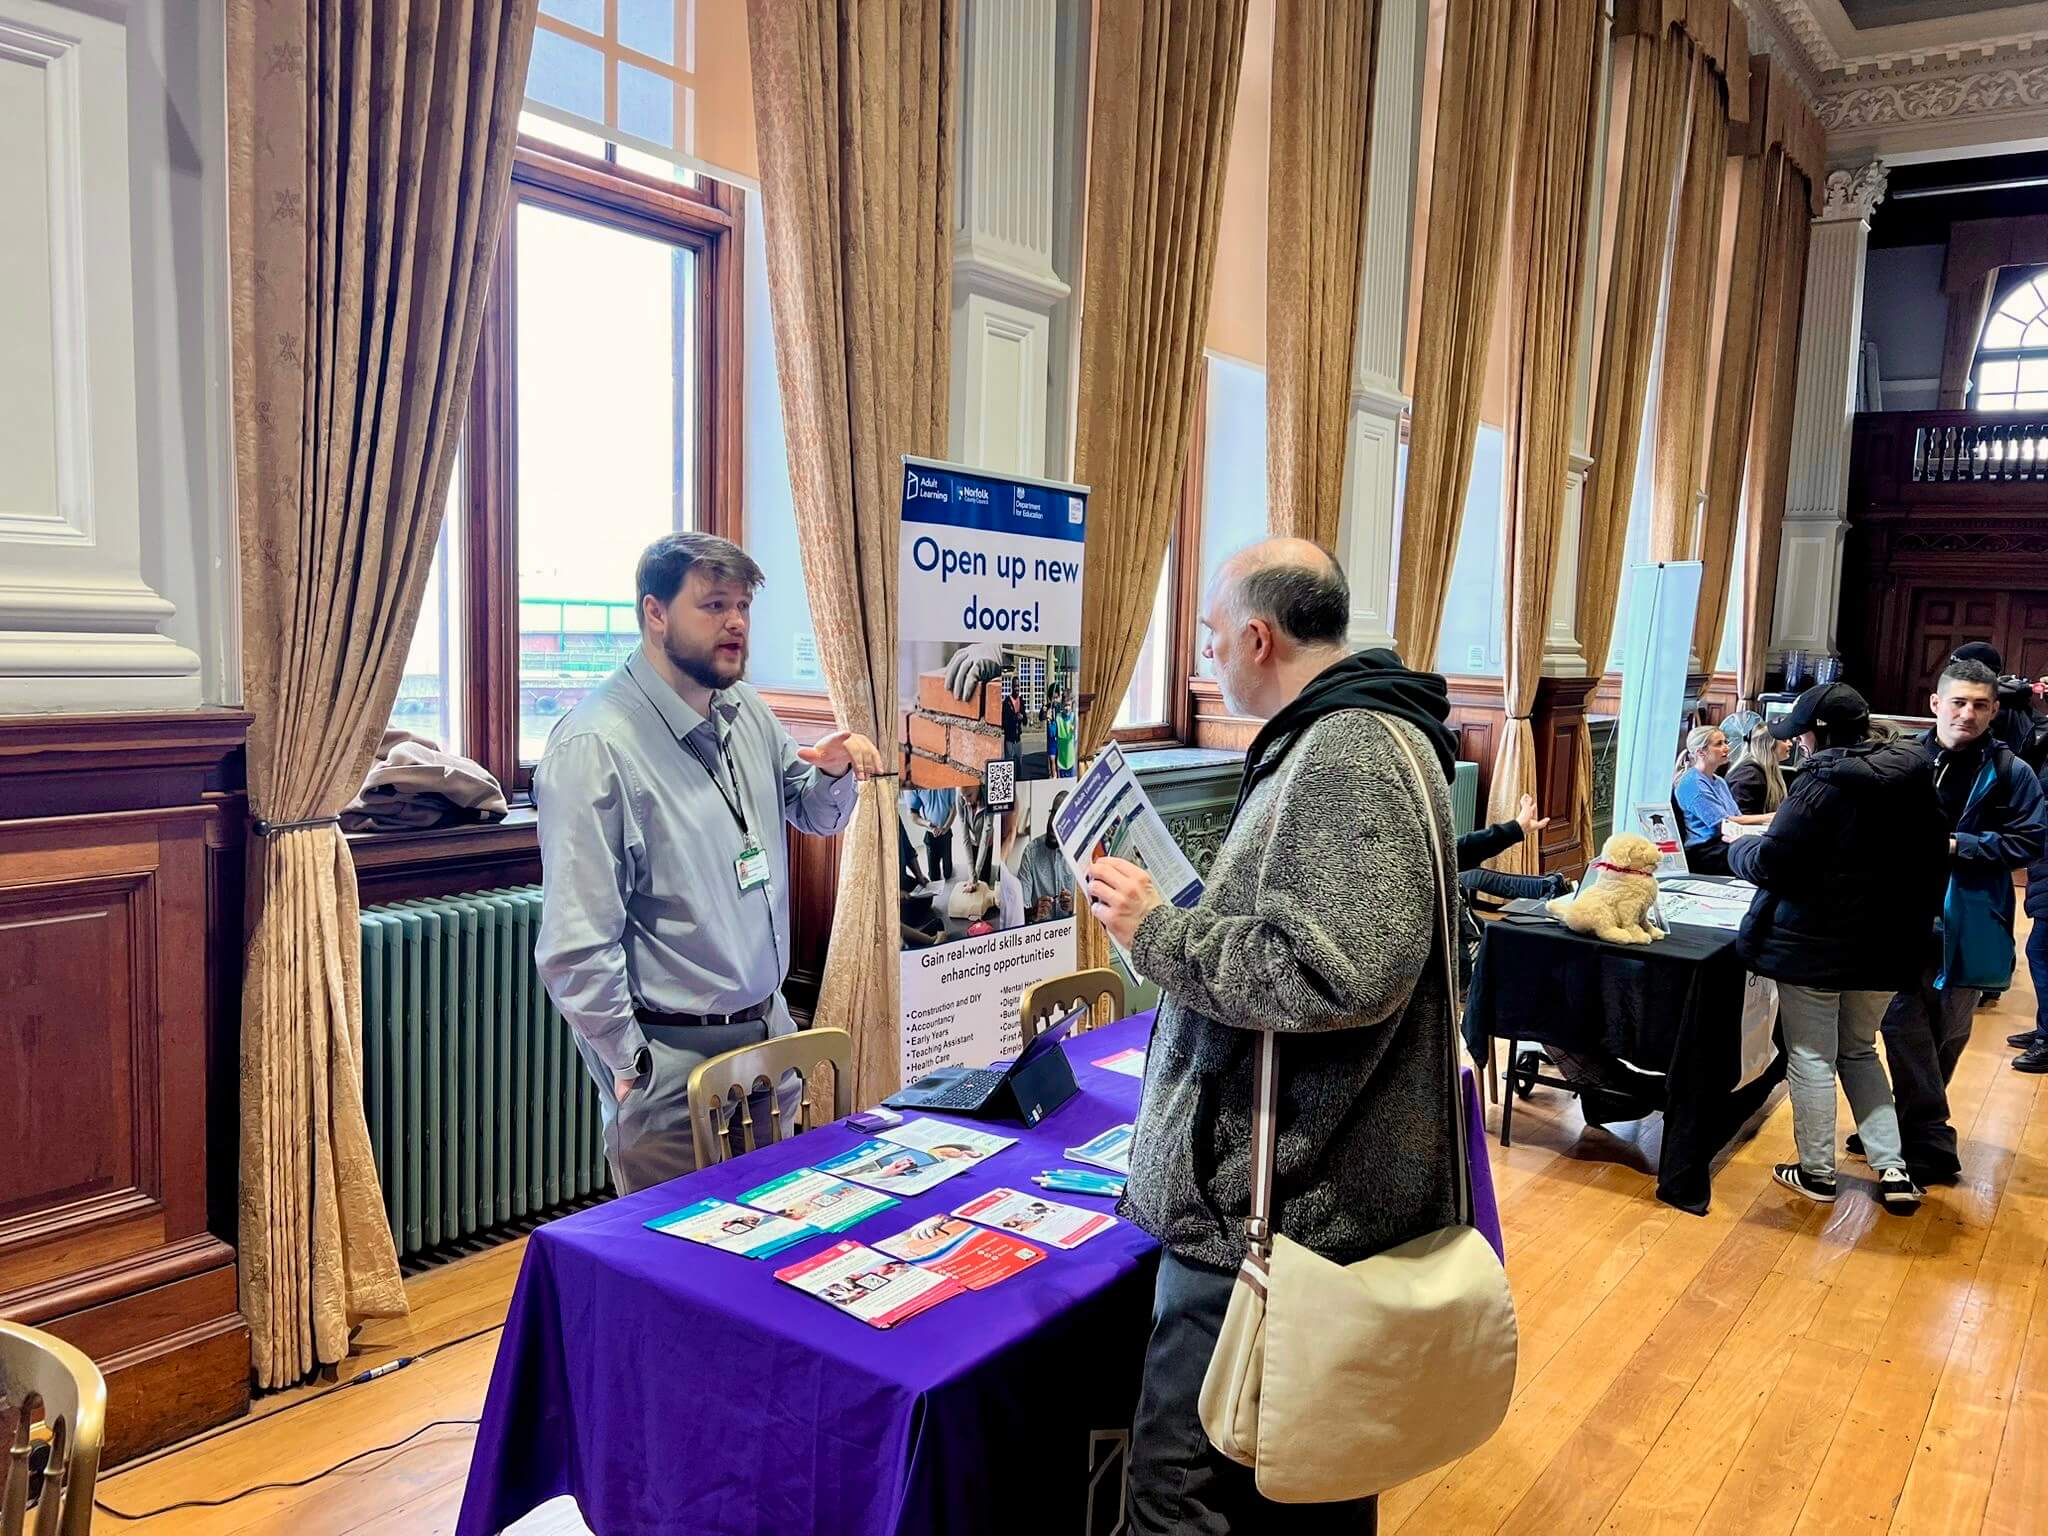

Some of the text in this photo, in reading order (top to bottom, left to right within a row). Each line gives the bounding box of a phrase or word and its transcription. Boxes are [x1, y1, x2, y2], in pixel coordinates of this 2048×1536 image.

[920, 477, 938, 488] Adult
[920, 488, 948, 503] Learning
[964, 487, 989, 499] Norfolk
[1015, 500, 1041, 511] Department
[1022, 510, 1044, 519] Education
[913, 536, 1079, 588] Open up new
[963, 595, 1039, 632] doors!
[921, 926, 1072, 968] Gain real-world skills and career
[941, 947, 1055, 983] enhancing opportunities
[1003, 983, 1023, 994] Mental
[911, 993, 982, 1019] Construction and DIY
[1003, 996, 1020, 1007] Digita
[911, 1014, 955, 1033] Accountancy
[911, 1029, 949, 1046] Early Years
[911, 1033, 974, 1058] Teaching Assistant
[1003, 1033, 1017, 1043] First
[911, 1059, 934, 1072] Health
[935, 1054, 950, 1065] Care
